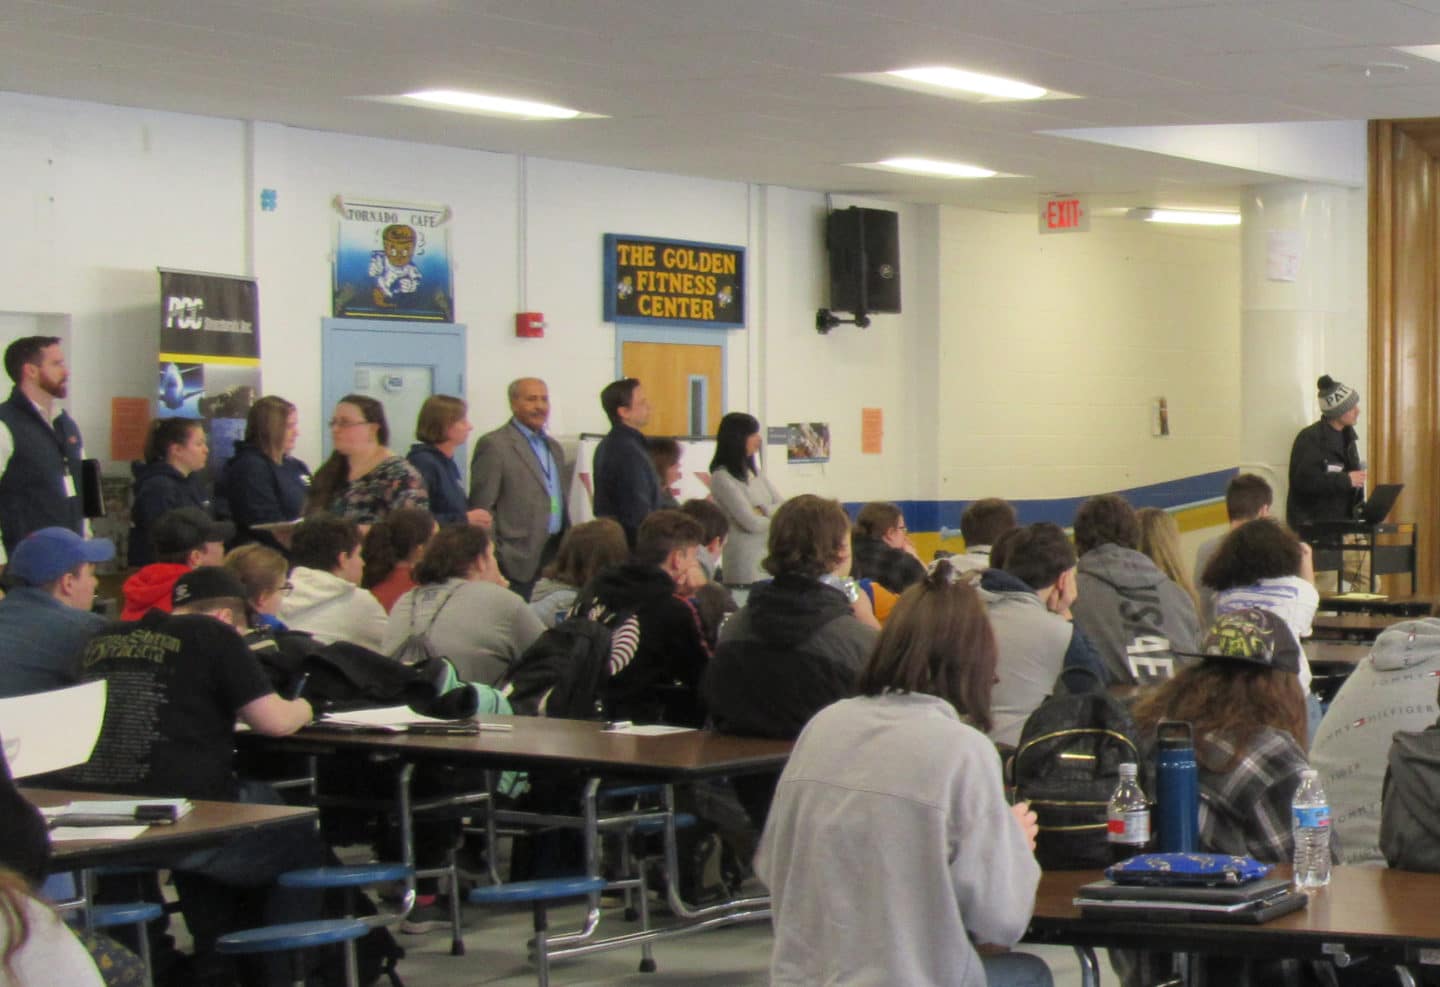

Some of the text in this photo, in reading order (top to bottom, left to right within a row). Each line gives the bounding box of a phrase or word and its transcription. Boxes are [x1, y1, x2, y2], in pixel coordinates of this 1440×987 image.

[347, 209, 436, 228] TORNADO CAFE
[1047, 199, 1080, 229] EXIT
[617, 244, 737, 274] THE GOLDEN
[636, 270, 717, 296] FITNESS
[167, 296, 204, 330] PCC
[637, 295, 716, 320] CENTER
